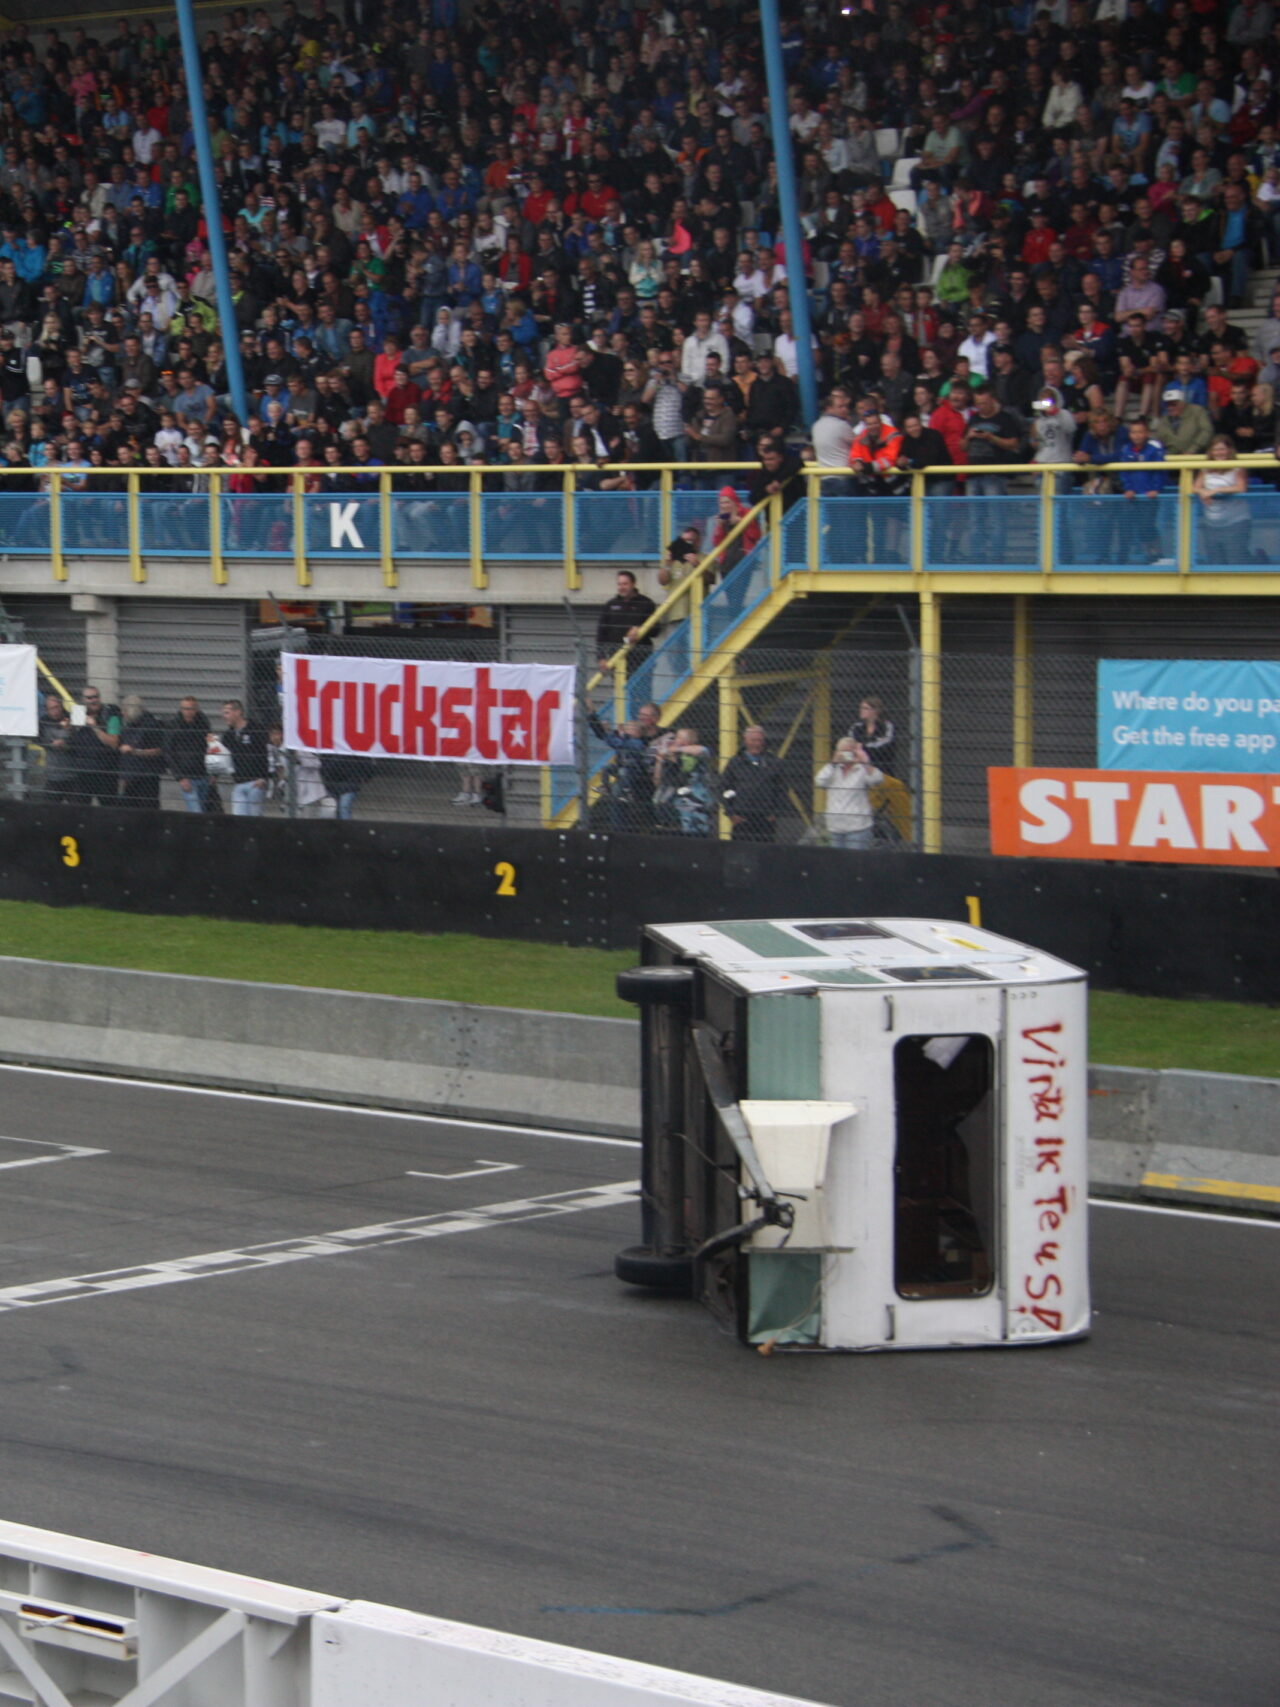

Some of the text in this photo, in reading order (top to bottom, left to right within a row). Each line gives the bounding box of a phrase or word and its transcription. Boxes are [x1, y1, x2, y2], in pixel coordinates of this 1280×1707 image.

[329, 502, 365, 549] K
[295, 658, 561, 762] truckstar
[1111, 689, 1178, 711] Where
[1183, 690, 1210, 711] do
[1213, 697, 1253, 717] you
[1112, 725, 1276, 754] Get the free app
[1019, 778, 1280, 852] STAR
[61, 835, 81, 868] 3
[494, 861, 517, 897] 2
[965, 895, 982, 928] 1
